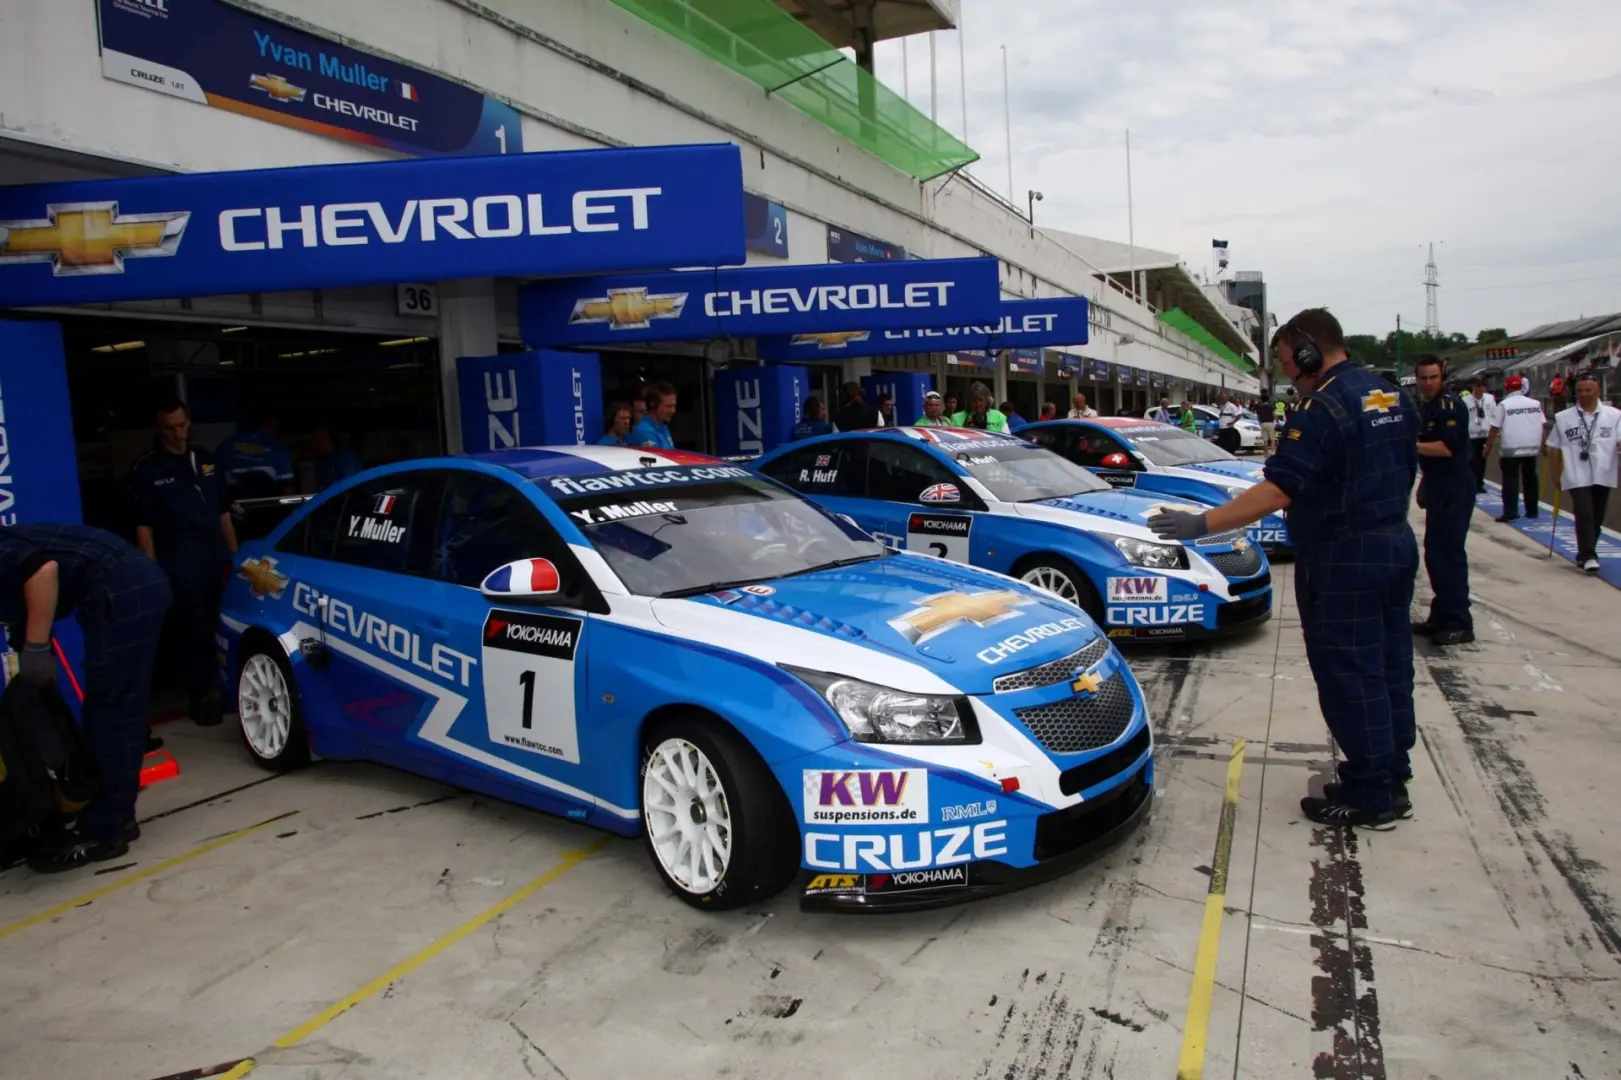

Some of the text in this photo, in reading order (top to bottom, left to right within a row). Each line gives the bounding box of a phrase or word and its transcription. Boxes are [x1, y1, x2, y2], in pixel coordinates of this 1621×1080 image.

[252, 28, 389, 93] Yvan Muller
[130, 68, 166, 85] CRUZE
[313, 92, 420, 132] CHEVROLET
[494, 124, 506, 154] 1
[218, 186, 662, 252] CHEVROLET
[774, 216, 783, 245] 2
[405, 287, 431, 311] 36
[704, 281, 955, 317] CHEVROLET
[1564, 427, 1579, 439] 107
[550, 465, 753, 496] fiawtcc.com
[800, 468, 838, 483] R. Huff
[569, 500, 678, 525] Y. Muller
[348, 515, 407, 544] Y. Muller
[923, 520, 967, 531] YOKOHAMA
[1115, 577, 1158, 595] KW
[1106, 604, 1204, 625] CRUZE
[292, 581, 477, 688] CHEVROLET
[506, 623, 572, 648] YOKOHAMA
[976, 617, 1086, 665] CHEVROLET
[1148, 627, 1183, 635] YOKOHAMA
[519, 670, 536, 730] 1
[504, 734, 564, 757] www.fiawtcc.com
[818, 770, 911, 807] KW
[813, 807, 918, 823] suspensions.de
[941, 801, 988, 822] RML
[804, 819, 1008, 871] CRUZE
[891, 868, 964, 885] YOKOHAMA
